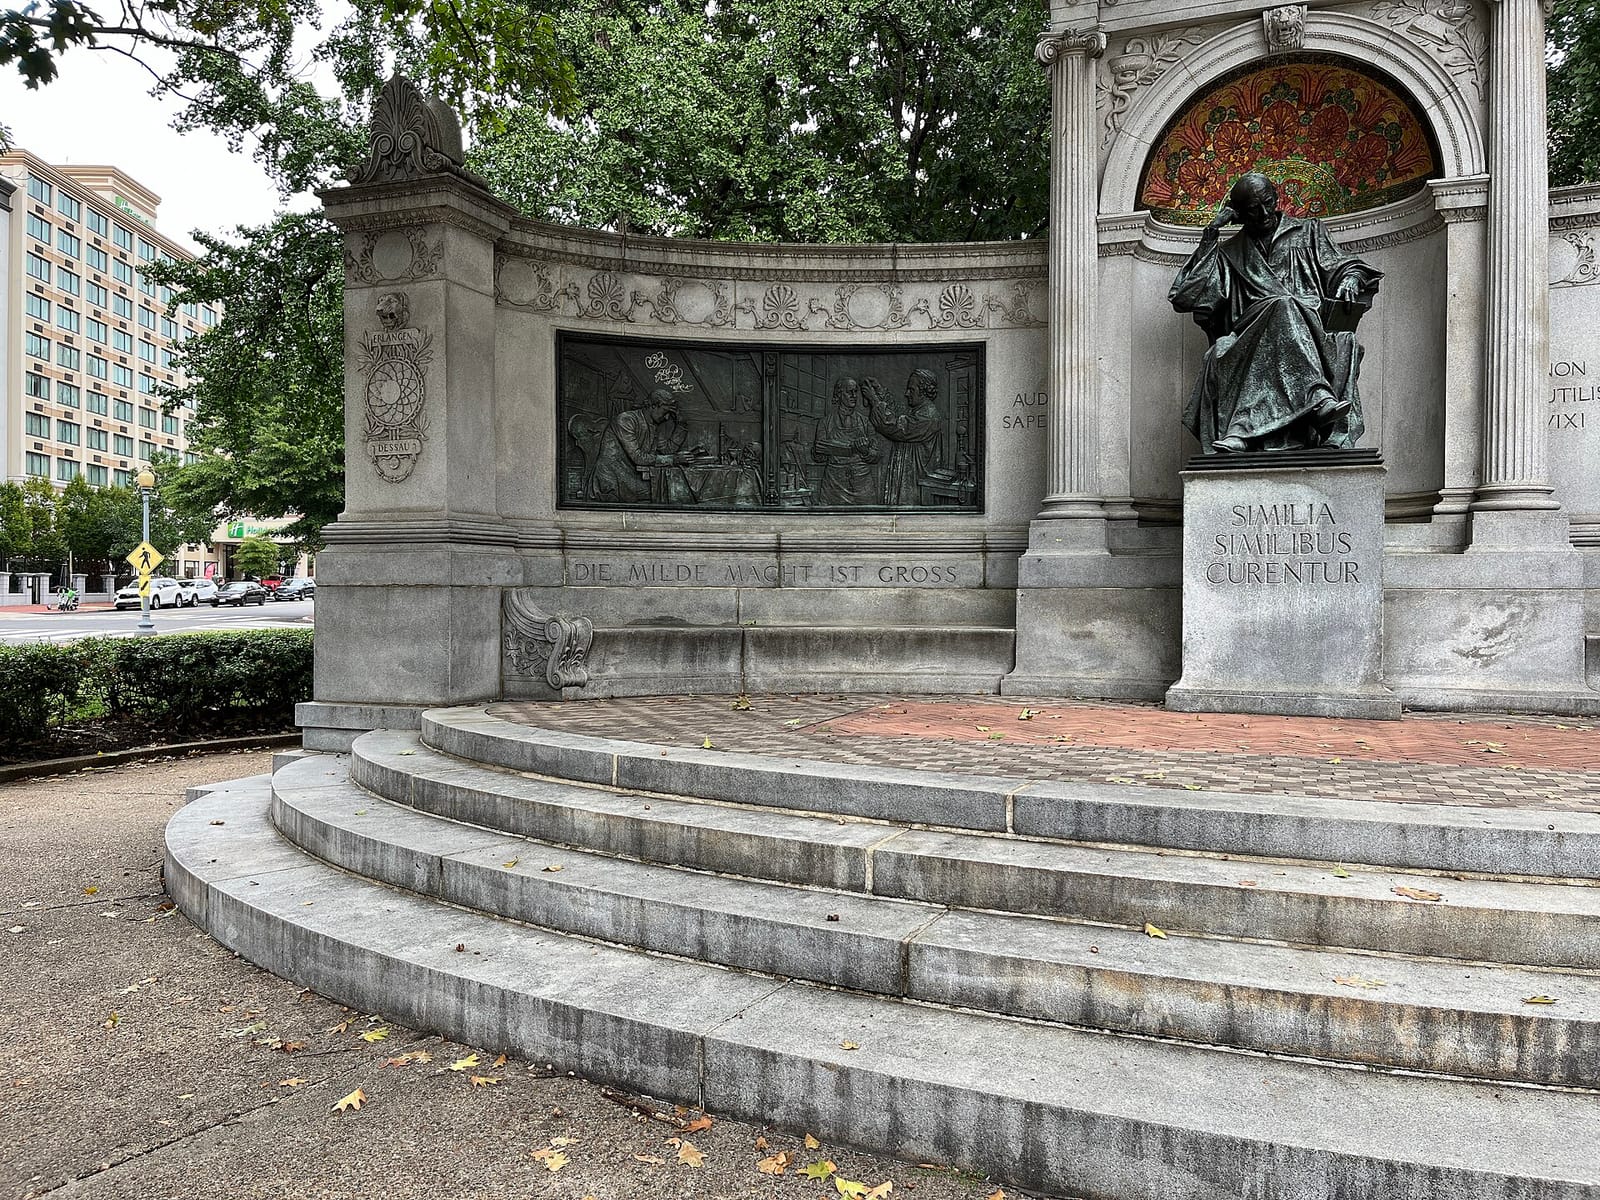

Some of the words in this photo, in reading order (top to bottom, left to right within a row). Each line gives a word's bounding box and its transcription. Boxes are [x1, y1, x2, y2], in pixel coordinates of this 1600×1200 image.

[373, 331, 413, 343] ERLANGEN
[378, 442, 410, 452] DESSAU
[1231, 503, 1336, 526] SIMILIA
[1213, 532, 1352, 556] SIMILIBUS
[575, 563, 612, 581] DIE
[628, 564, 707, 582] MILDE
[724, 565, 812, 583] MACHT
[831, 565, 864, 583] IST
[878, 566, 957, 583] GROSS
[1206, 561, 1361, 584] CURENTUR
